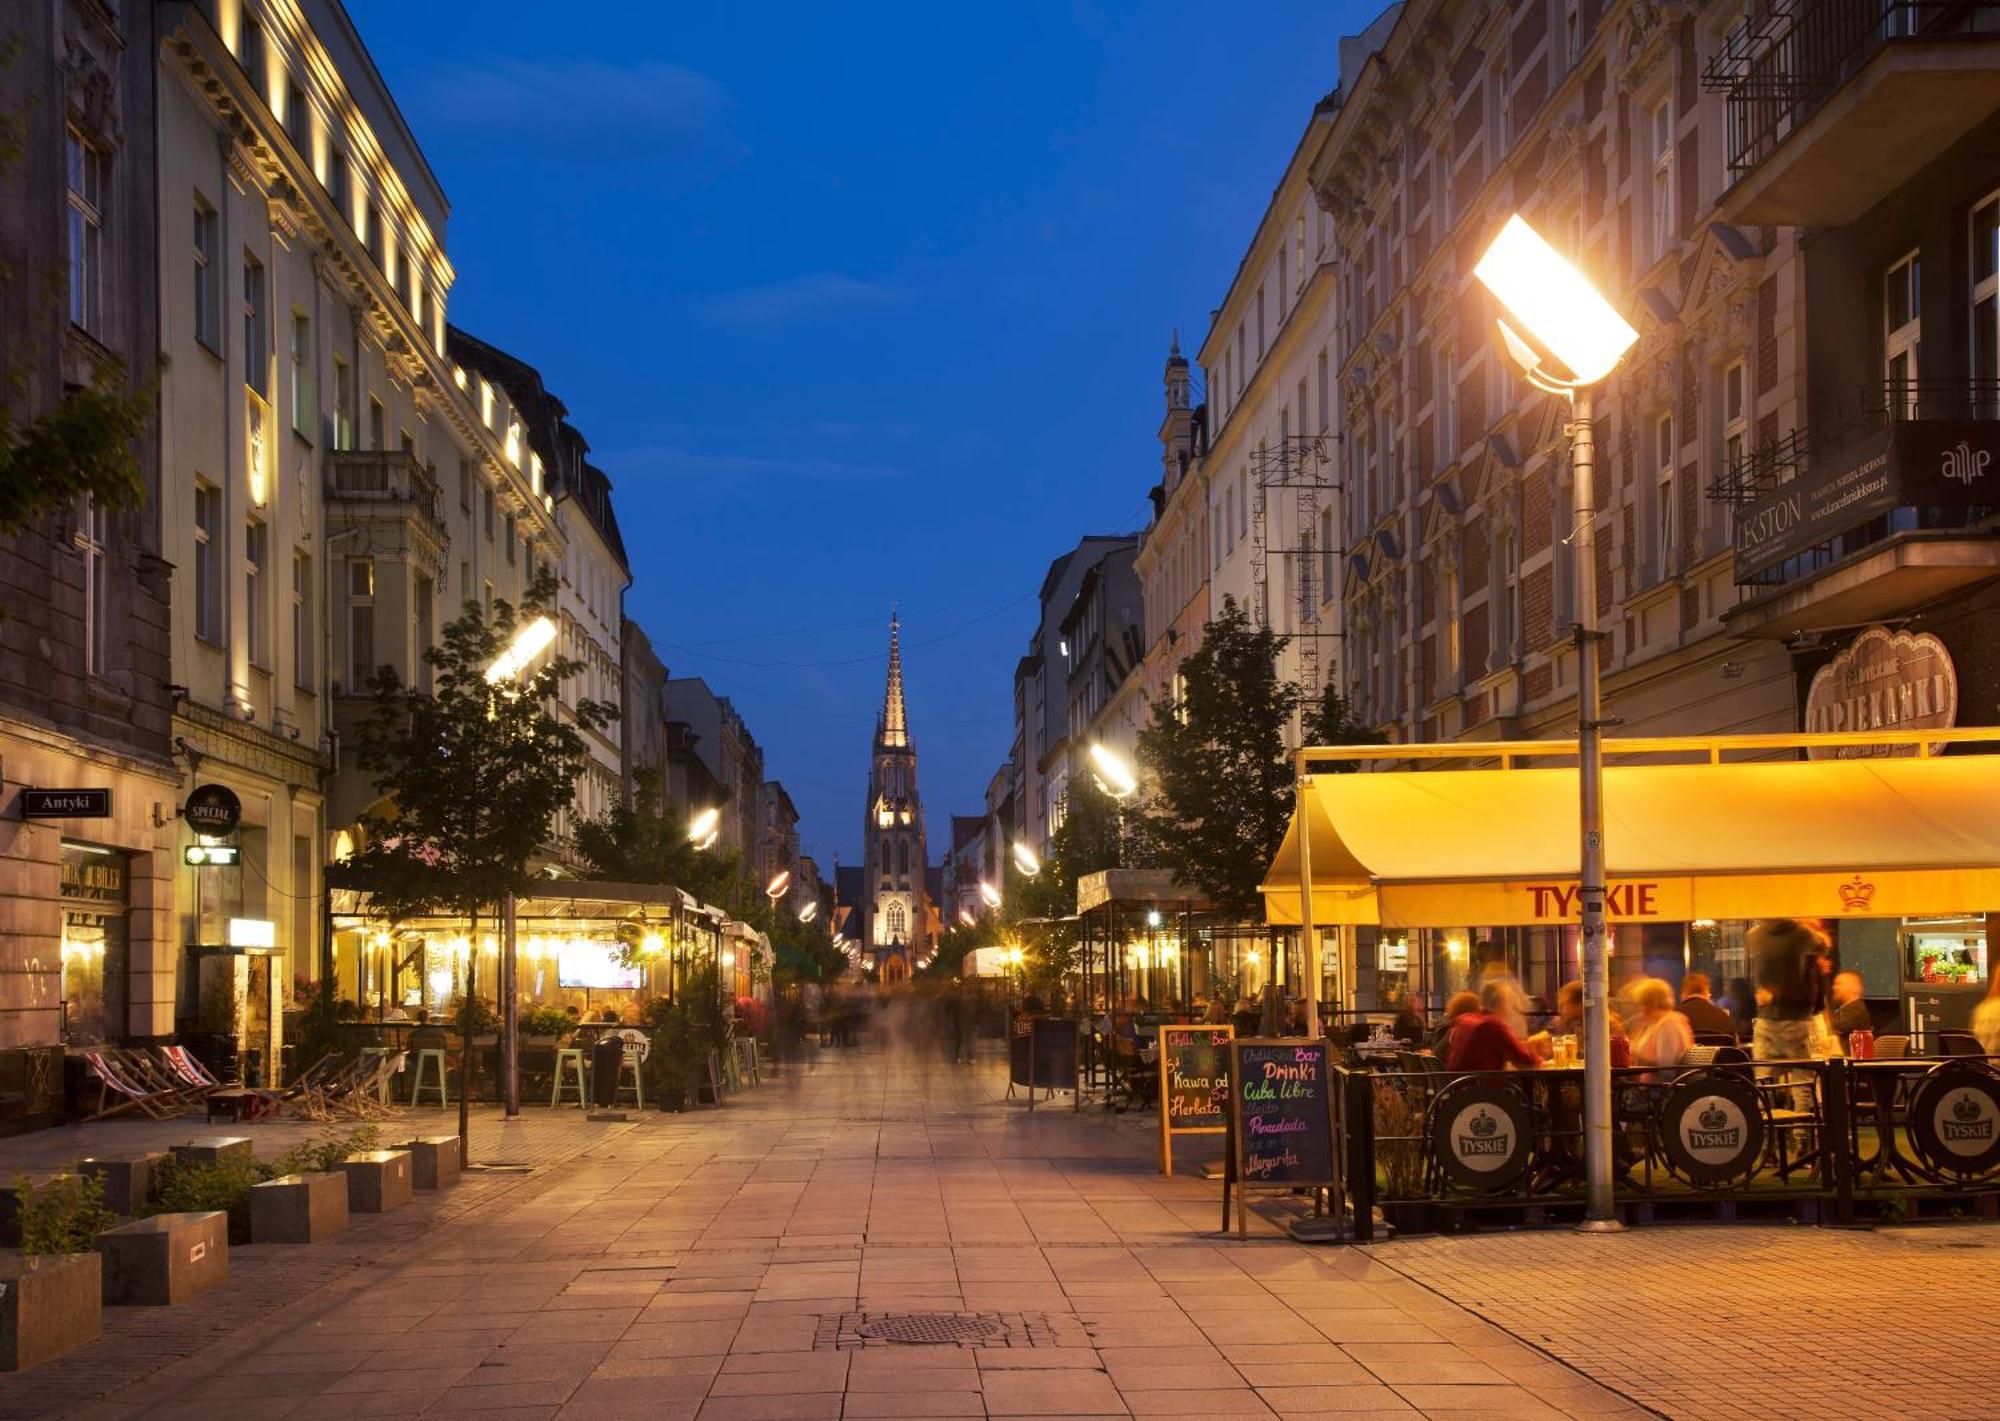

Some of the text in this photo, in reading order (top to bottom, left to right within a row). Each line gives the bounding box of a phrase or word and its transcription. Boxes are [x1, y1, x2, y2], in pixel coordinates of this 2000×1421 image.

[42, 796, 90, 811] Antyki
[1294, 1046, 1320, 1062] Bar
[1174, 1071, 1229, 1089] Kawa od
[1243, 1080, 1277, 1100] Cuba
[1170, 1095, 1222, 1117] Herbata
[1945, 1120, 1991, 1139] TYSKIE
[1461, 1136, 1506, 1154] TYSKIE
[1691, 1130, 1738, 1148] TYSKIE
[1245, 1149, 1300, 1178] Margarita
